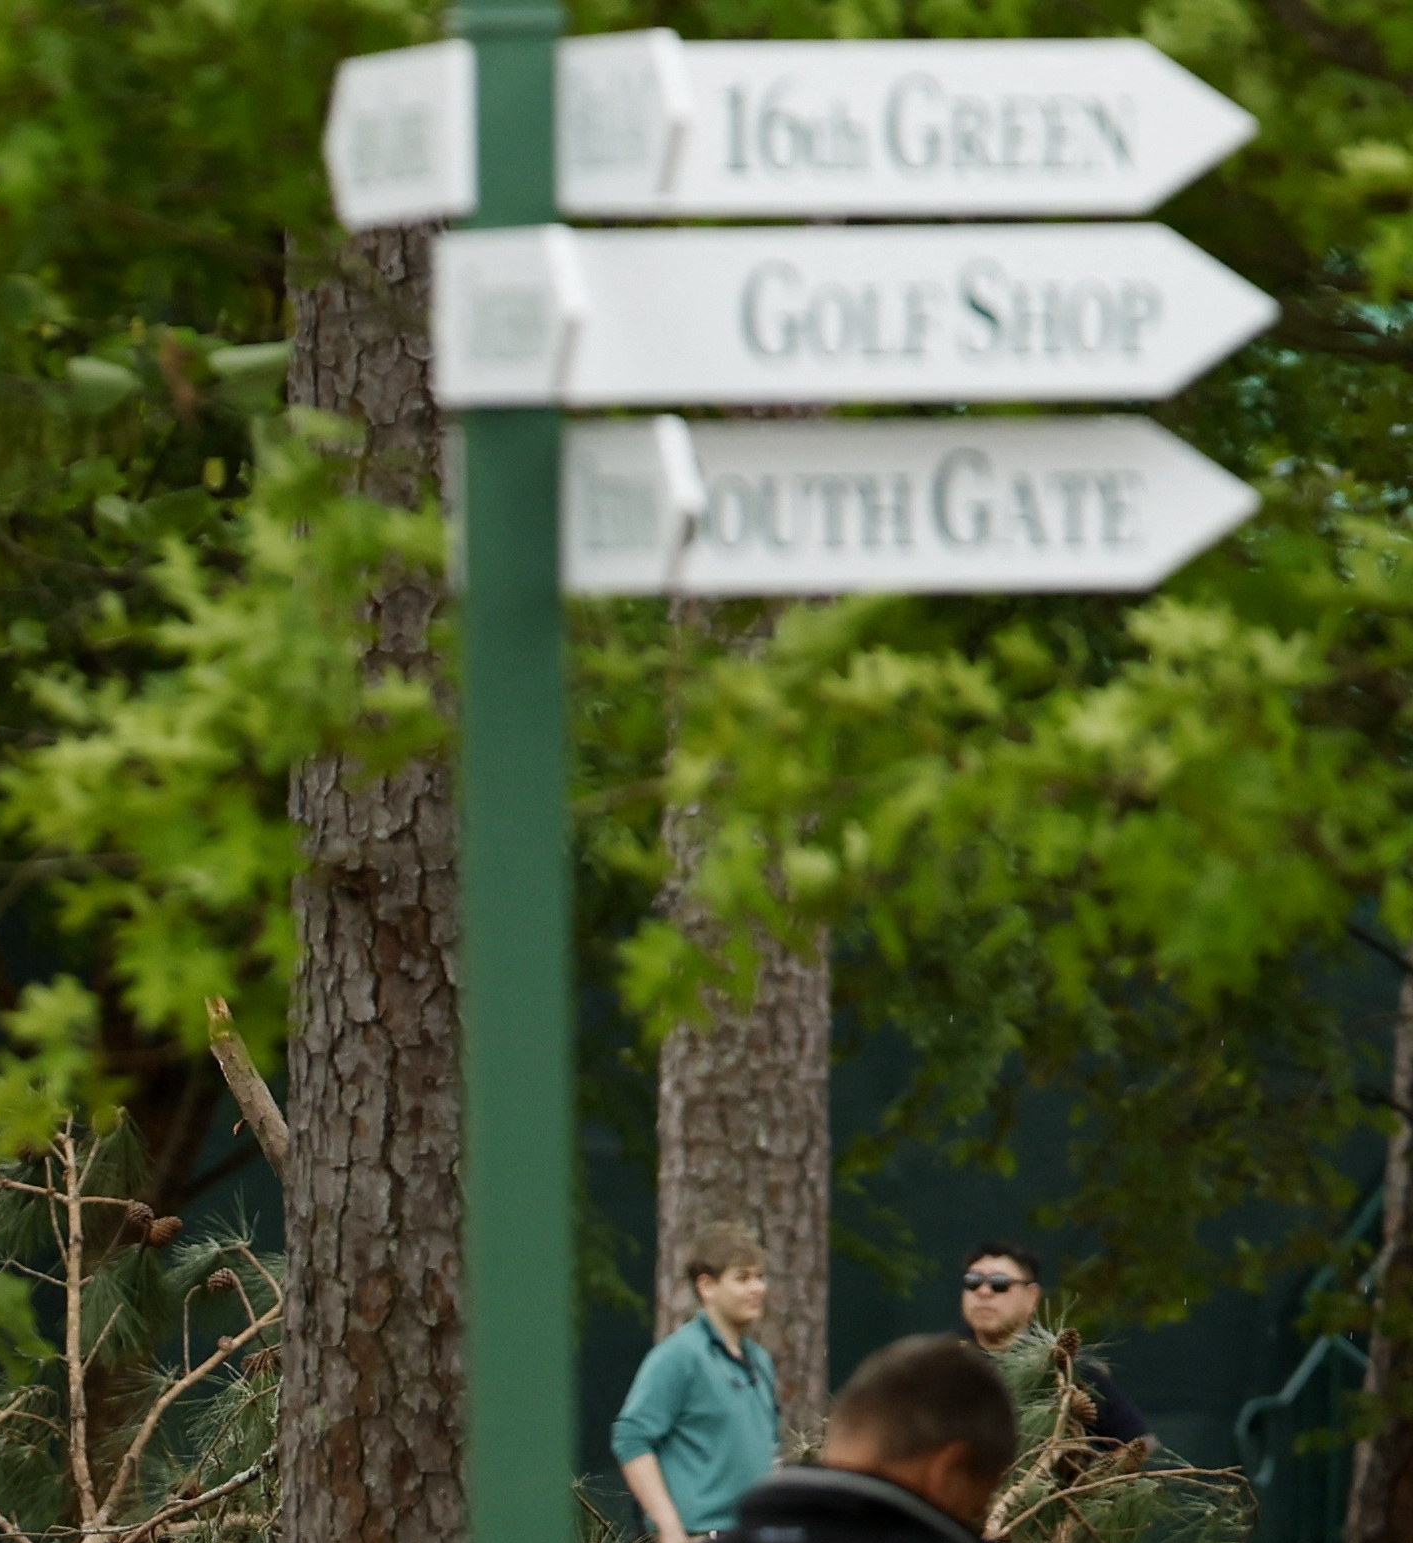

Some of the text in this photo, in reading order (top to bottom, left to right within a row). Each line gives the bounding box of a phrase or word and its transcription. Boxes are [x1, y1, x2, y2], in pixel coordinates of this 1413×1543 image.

[722, 76, 872, 172] 16th
[882, 70, 1140, 174] GREEN
[738, 257, 1165, 363] GOLF SHOP
[699, 470, 913, 548] OUTH
[931, 446, 1146, 550] GATE
